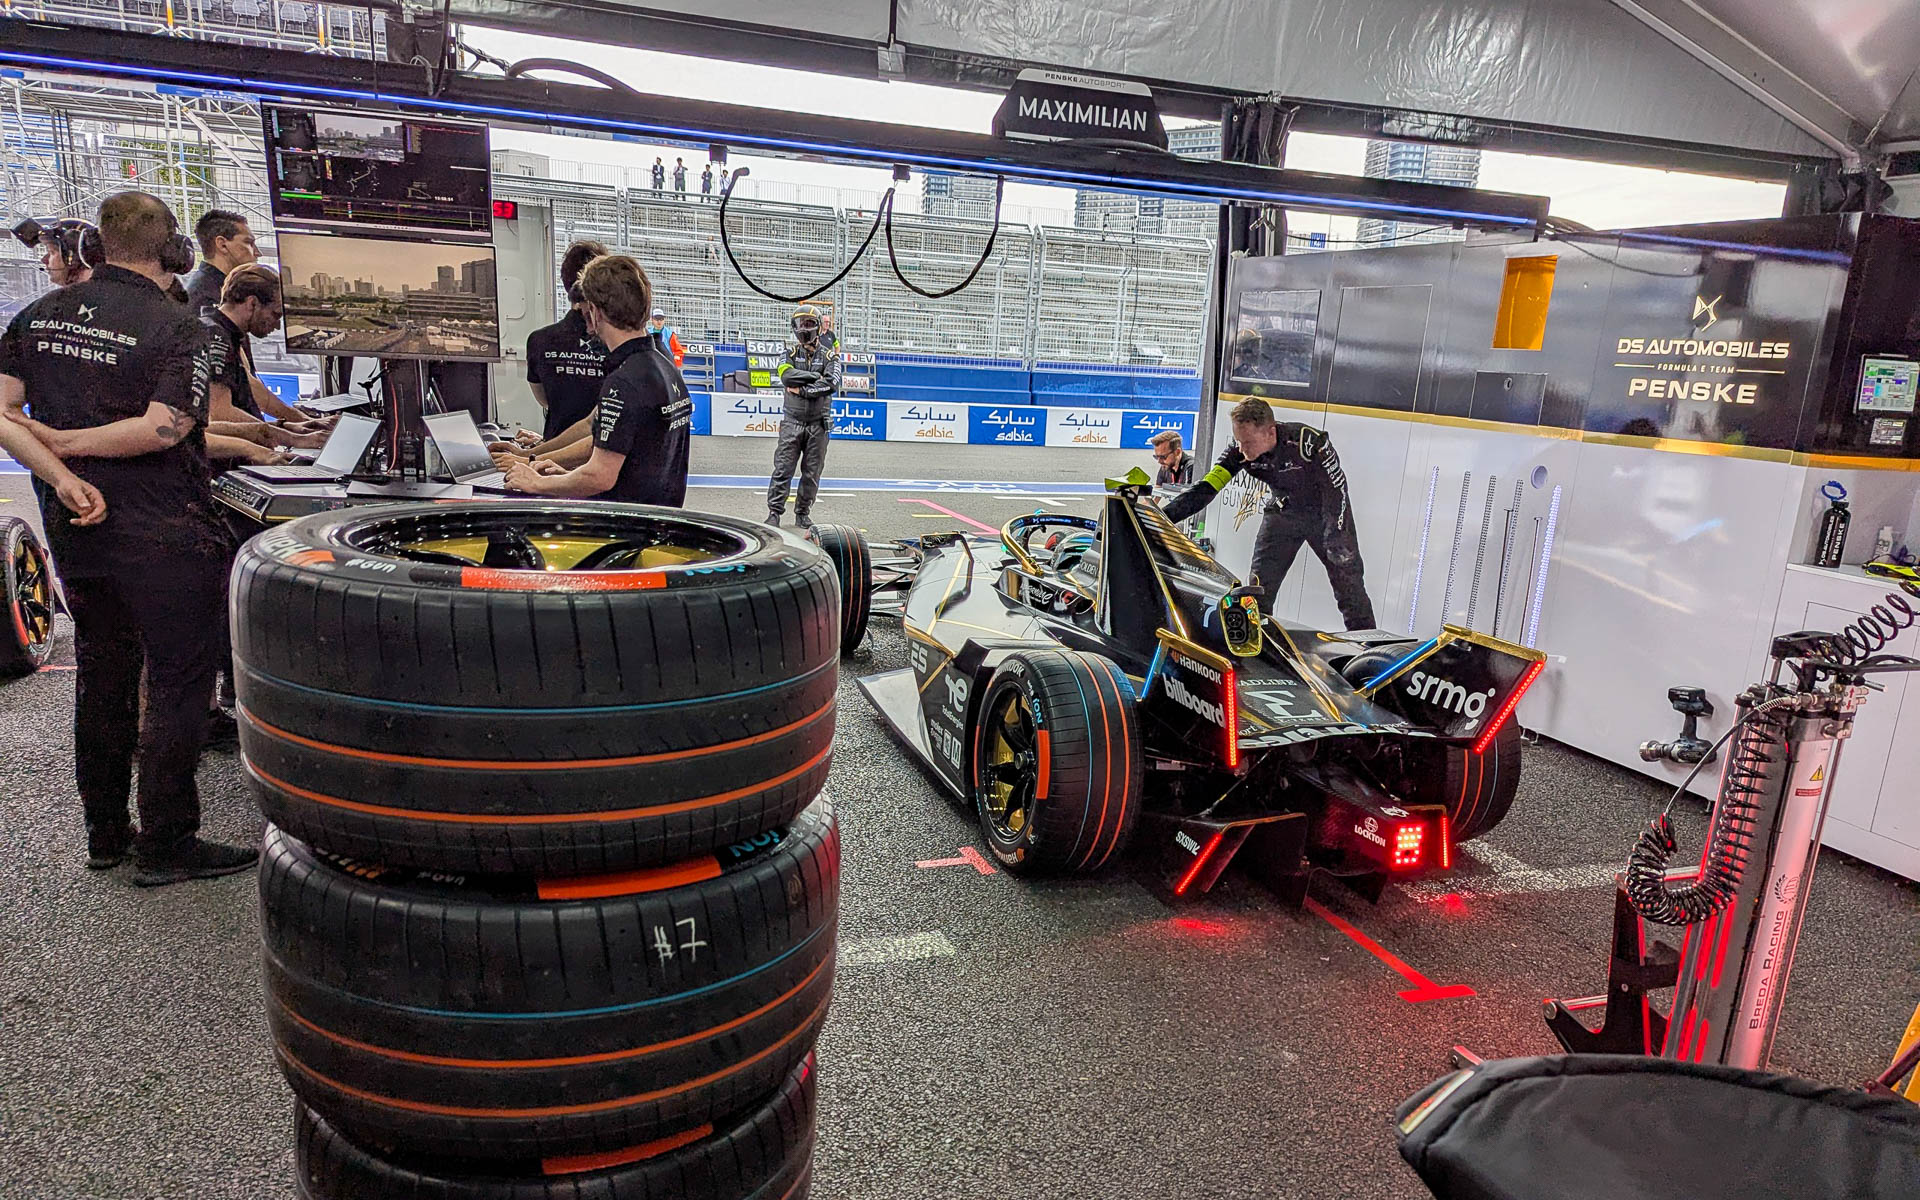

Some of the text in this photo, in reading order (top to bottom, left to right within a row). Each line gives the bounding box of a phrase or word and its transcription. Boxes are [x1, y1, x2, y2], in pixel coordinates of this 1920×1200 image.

[1045, 72, 1127, 89] PENSKE AUTOSPORT
[1018, 95, 1147, 132] MAXIMILIAN
[30, 320, 137, 346] DS AUTOMOBILES
[37, 341, 118, 365] PENSKE
[544, 351, 557, 359] DS
[688, 344, 712, 354] GUE
[748, 342, 784, 353] 5678
[1617, 338, 1790, 359] DS AUTOMOBILES
[852, 354, 873, 363] JEV
[1657, 363, 1734, 374] FORMULA E TEAM
[843, 377, 859, 388] Radio
[1628, 378, 1757, 404] PENSKE
[743, 417, 781, 433] sabi
[900, 406, 956, 425] سابك
[981, 409, 1035, 429] سابك
[1059, 412, 1110, 431] سابك
[1132, 414, 1183, 433] سابك
[831, 420, 874, 436] sabic
[915, 424, 955, 438] sabic
[995, 427, 1034, 442] sabic
[1072, 429, 1108, 444] sabic
[1831, 523, 1845, 560] PENSKE
[1203, 596, 1218, 628] 7
[1162, 672, 1226, 729] billboard
[1406, 670, 1496, 730] srmg
[1354, 824, 1386, 848] LOCKTON
[653, 918, 707, 967] #7
